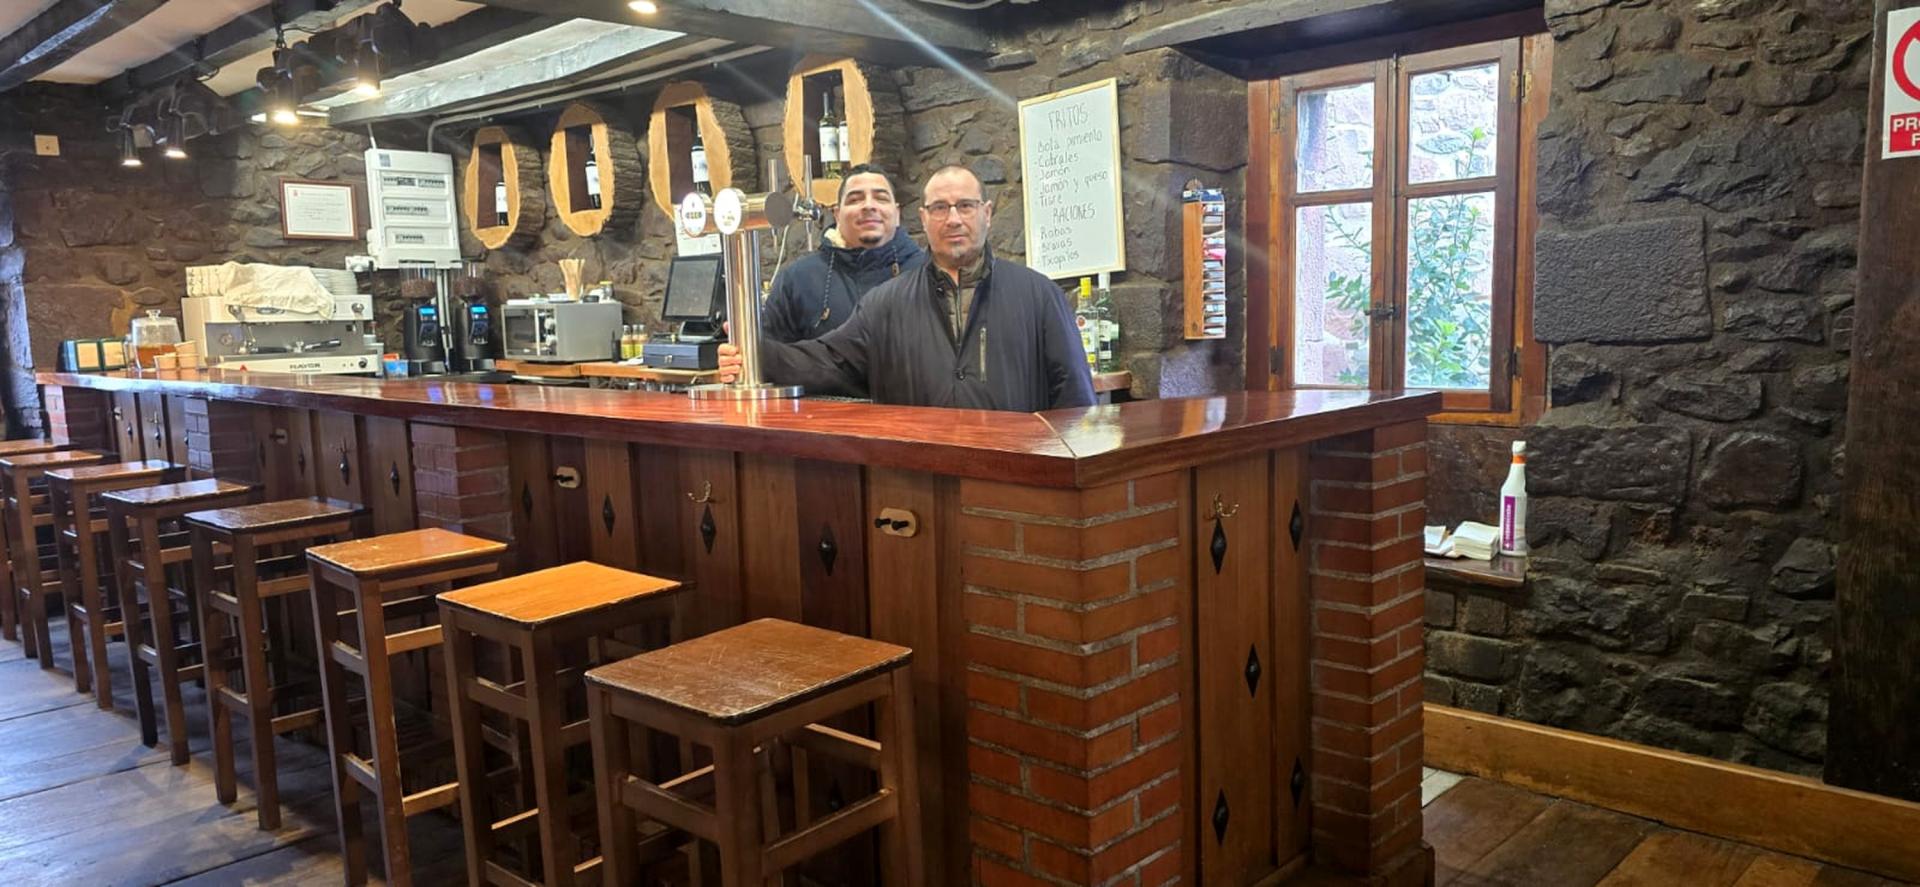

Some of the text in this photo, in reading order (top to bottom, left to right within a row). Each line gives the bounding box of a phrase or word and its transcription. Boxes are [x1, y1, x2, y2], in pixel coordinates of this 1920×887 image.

[1048, 102, 1089, 131] FRITOS
[1892, 117, 1920, 133] PR
[1073, 177, 1080, 193] y
[1084, 171, 1108, 189] queso
[1053, 203, 1095, 224] RACIONES
